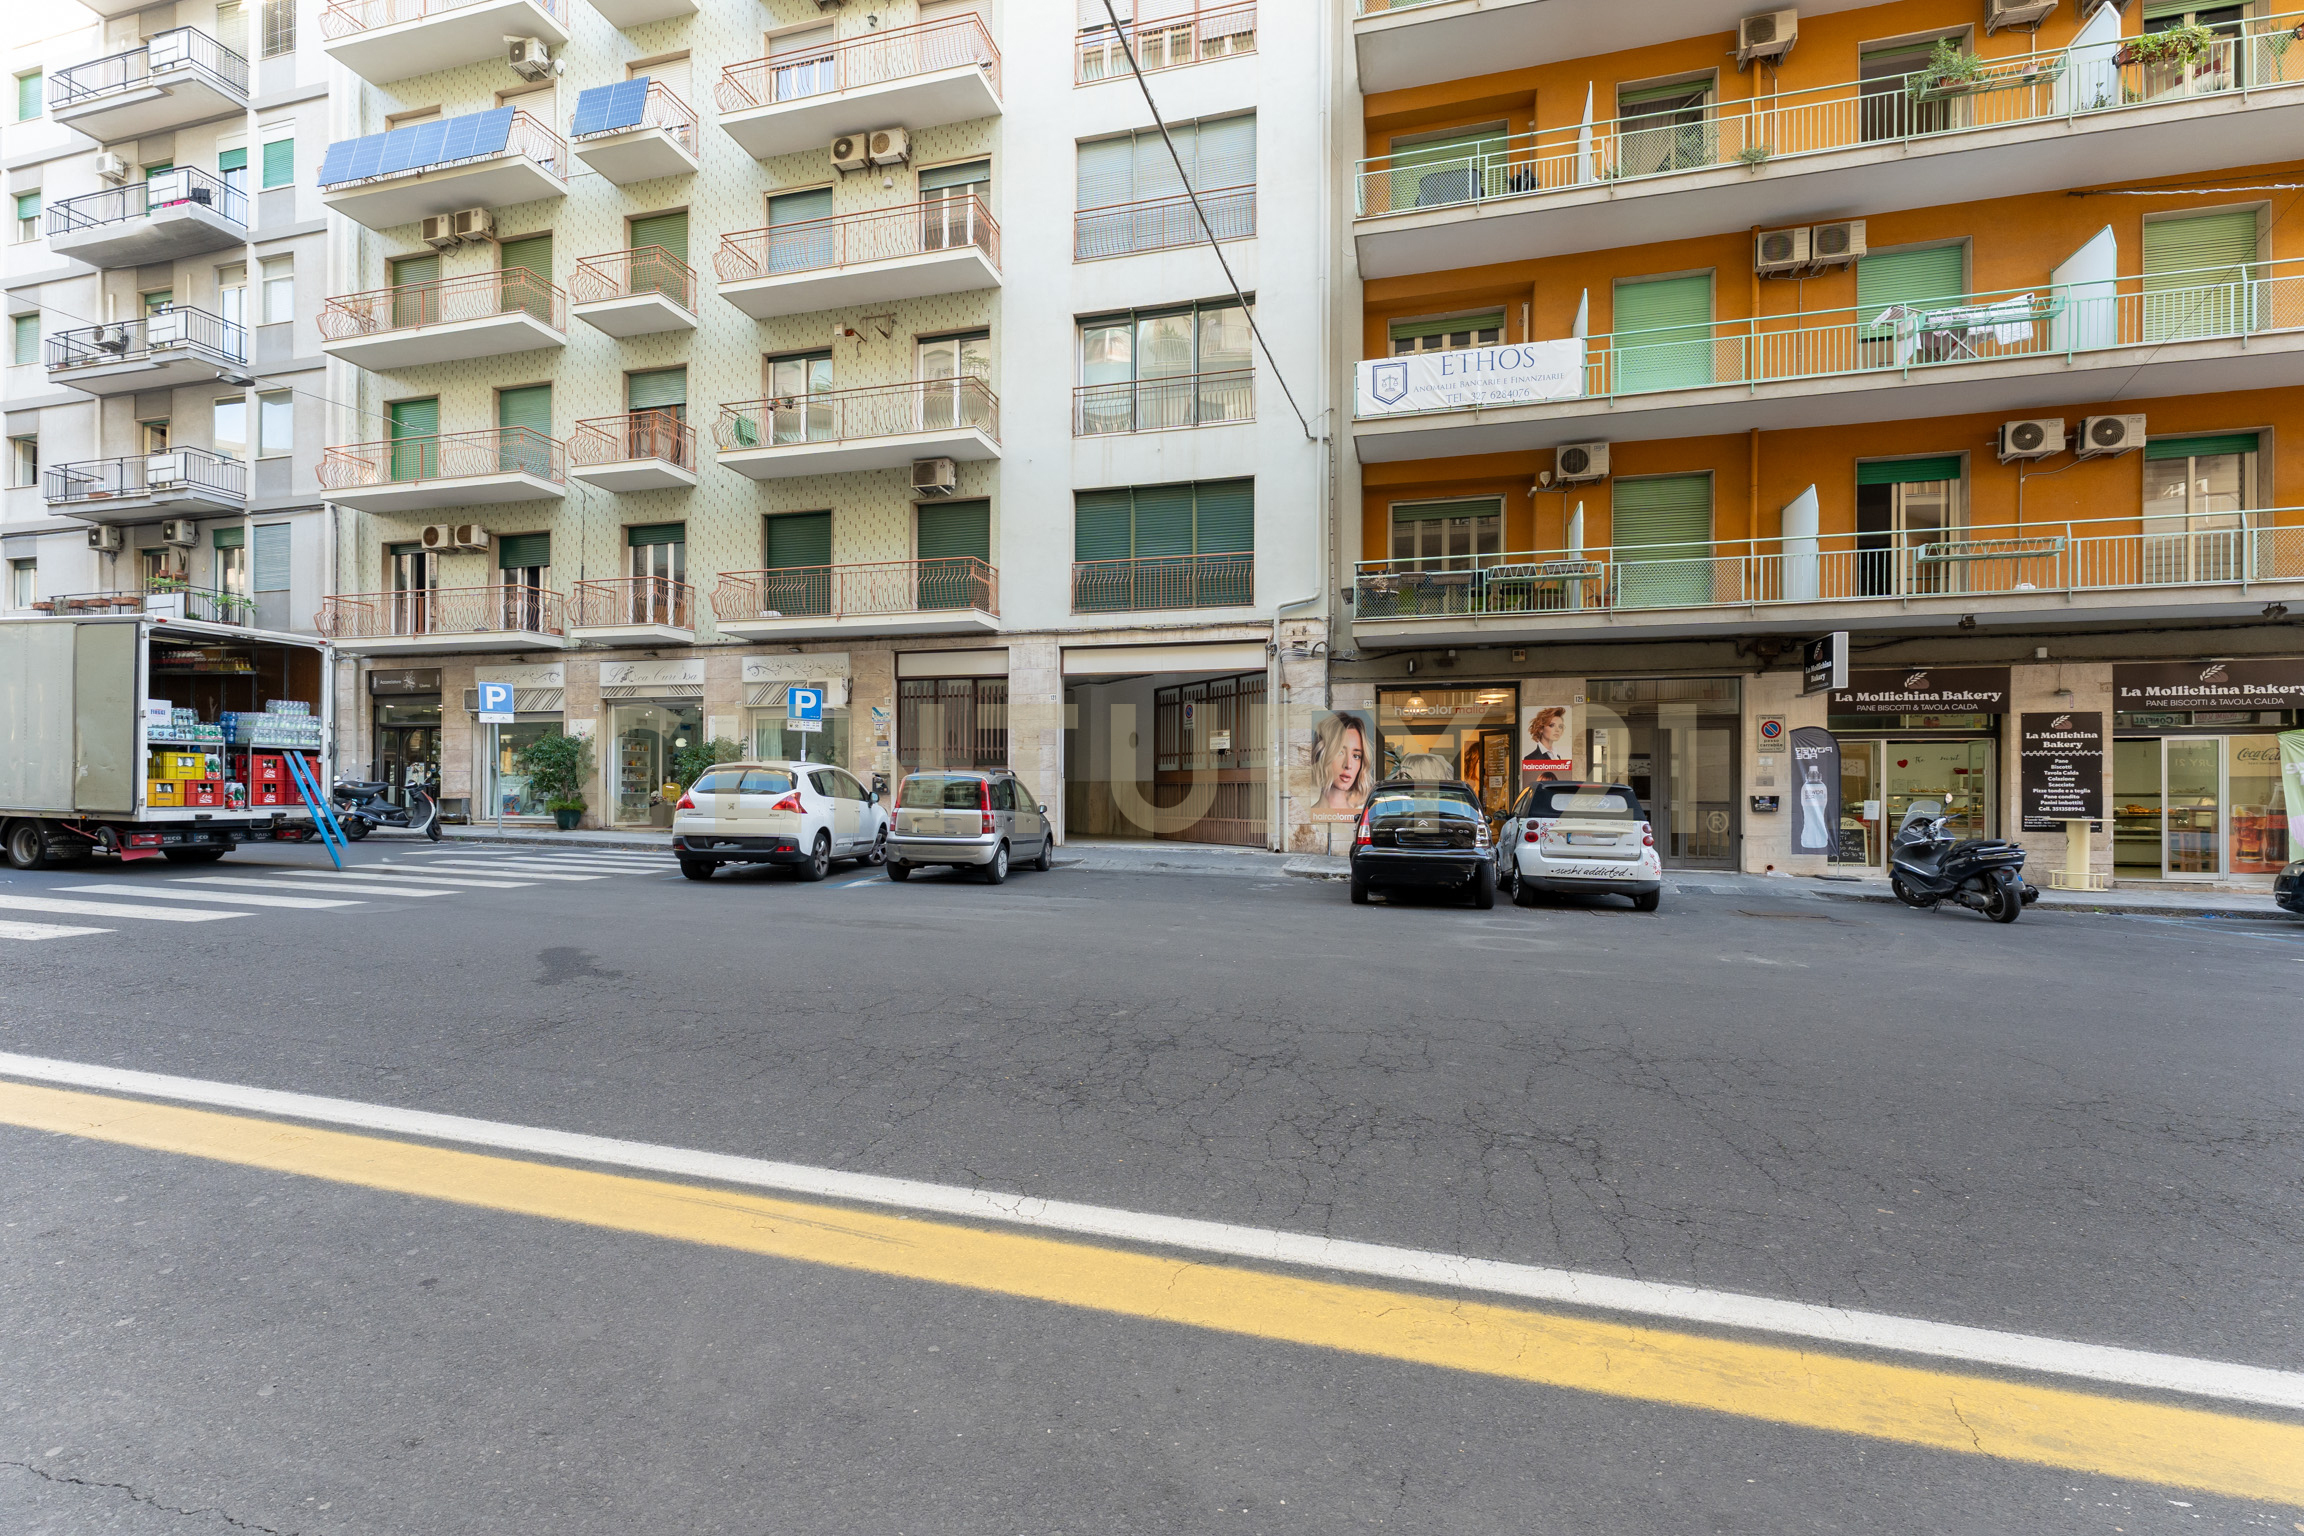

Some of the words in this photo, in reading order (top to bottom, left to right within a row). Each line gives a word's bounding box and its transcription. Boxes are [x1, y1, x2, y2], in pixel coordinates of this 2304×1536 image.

[1441, 346, 1535, 376] ETHOS
[1413, 382, 1457, 393] ANOMALIE
[1459, 377, 1501, 390] BANCARIE
[1510, 372, 1565, 384] FINANZIARIE
[1445, 393, 1467, 405] TEL.
[1471, 391, 1487, 402] 327
[1489, 387, 1530, 400] 6284076
[1811, 673, 1826, 682] Bakery
[1834, 692, 1853, 702] La
[1855, 690, 1940, 702] Mollichina
[1941, 690, 2002, 703] Bakery
[2121, 686, 2142, 697] La
[2145, 684, 2240, 697] Mollichina
[2243, 683, 2304, 696] Bakery
[486, 685, 507, 710] P
[795, 690, 817, 717] P
[2210, 698, 2217, 706] &
[2219, 698, 2252, 706] TAVOLA
[2254, 697, 2284, 705] CALDA
[1394, 703, 1452, 717] haircolor
[1455, 704, 1486, 715] malia
[1912, 703, 1919, 711] &
[1921, 703, 1950, 711] TAVOLA
[2040, 731, 2098, 739] Mollichina
[2042, 741, 2083, 749] Bakery
[1312, 812, 1355, 821] haircolorm
[1555, 865, 1582, 875] sushi
[1583, 866, 1629, 878] addicted
